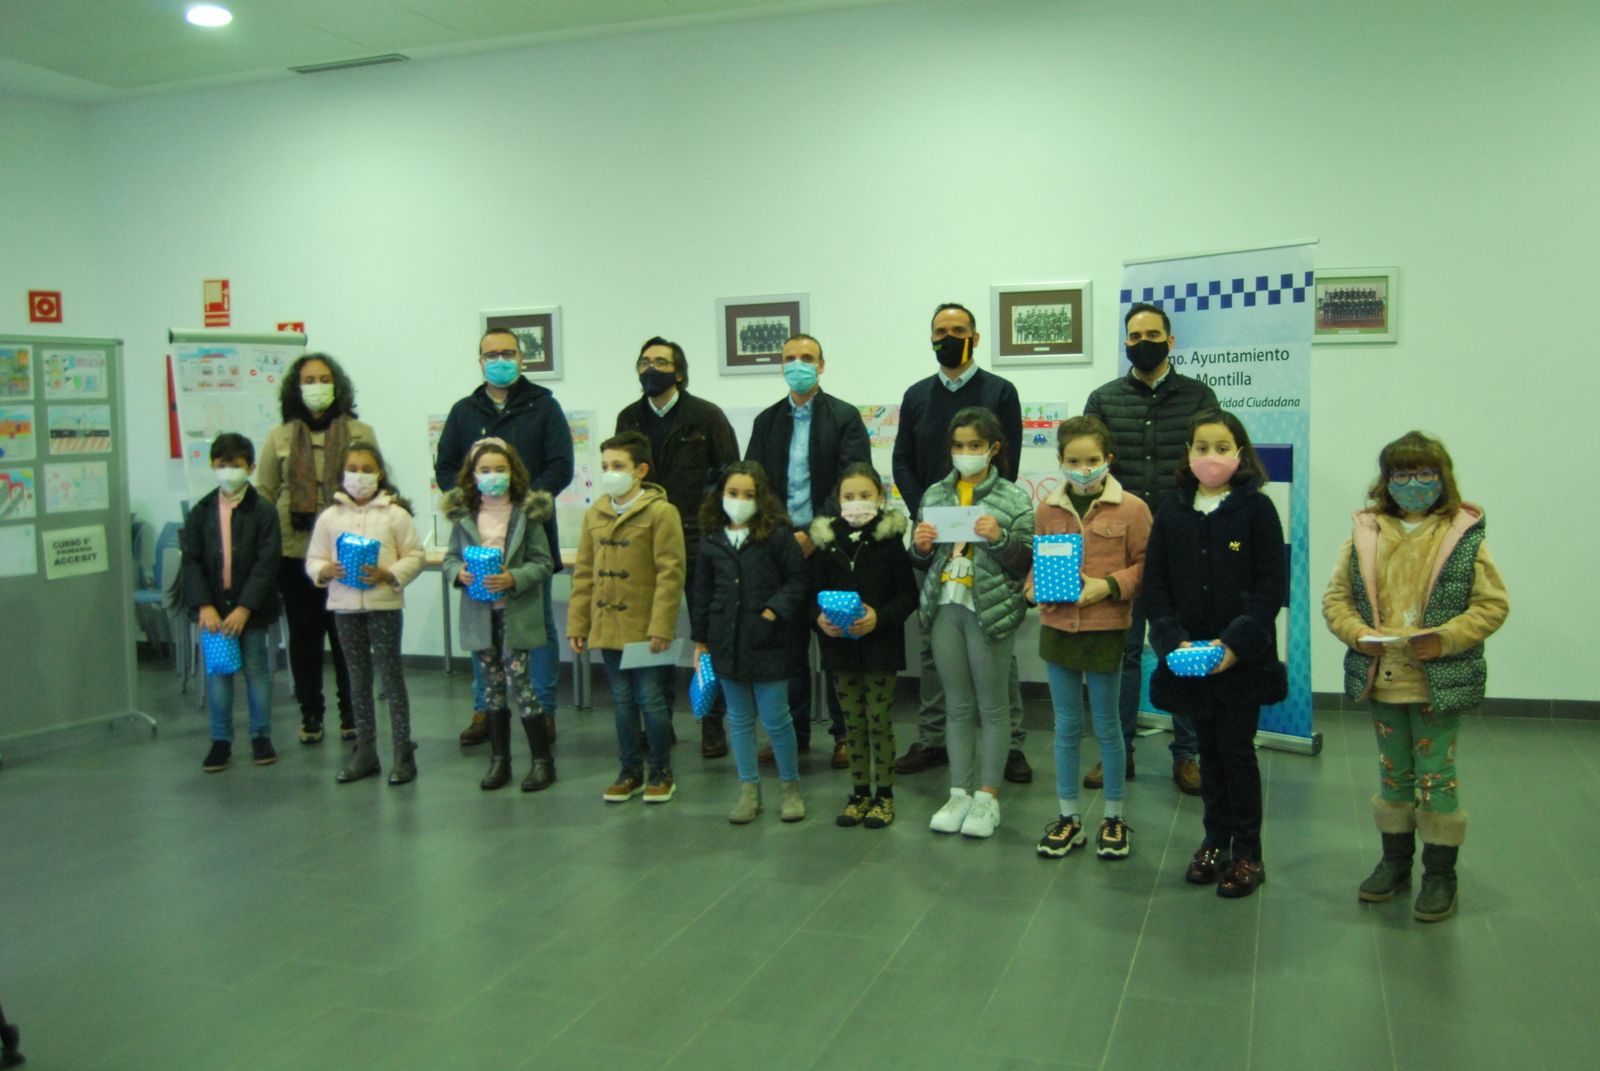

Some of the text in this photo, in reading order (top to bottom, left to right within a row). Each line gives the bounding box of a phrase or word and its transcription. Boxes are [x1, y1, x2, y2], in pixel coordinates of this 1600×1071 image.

[1191, 348, 1290, 367] Ayuntamiento
[1196, 371, 1252, 387] Montilla
[1219, 396, 1301, 408] ridad Ciudadana
[53, 538, 82, 550] CURSO
